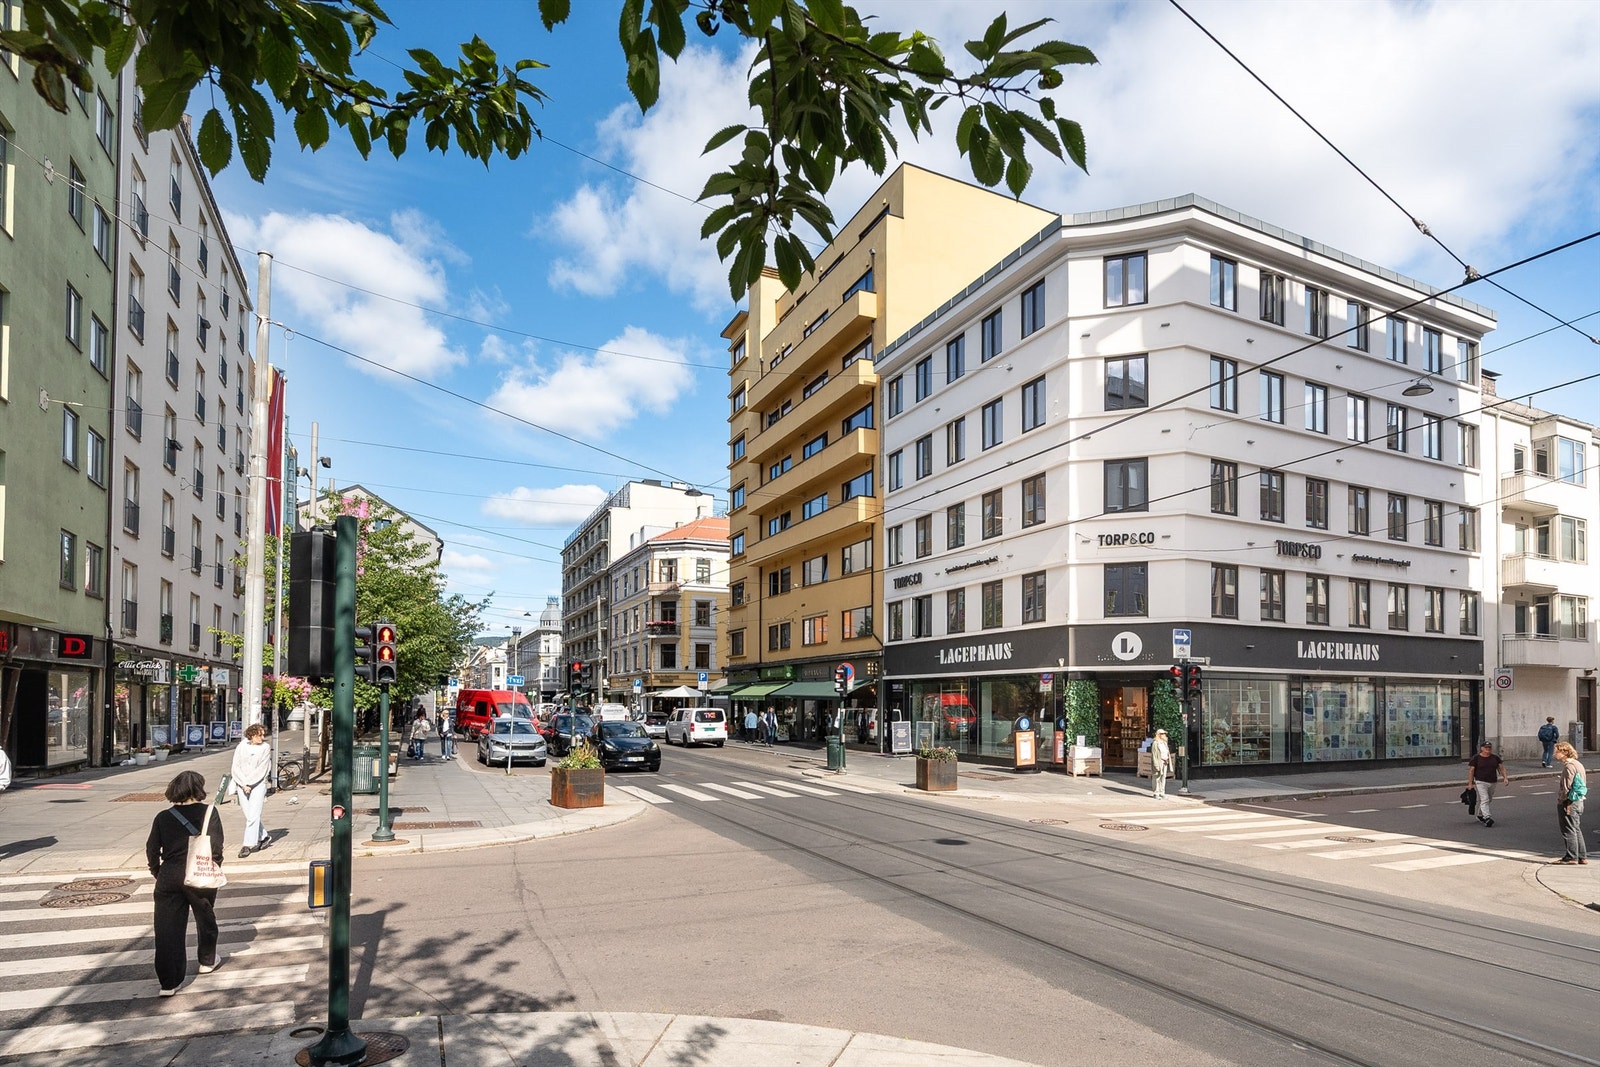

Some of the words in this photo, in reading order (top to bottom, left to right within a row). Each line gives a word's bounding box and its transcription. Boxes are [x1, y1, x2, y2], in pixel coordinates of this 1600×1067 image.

[1097, 531, 1155, 547] TORP&CO
[1276, 539, 1322, 560] TORP&CO
[893, 572, 923, 589] TORP&CO
[938, 642, 1013, 665] LAGERHAUS
[1297, 640, 1380, 661] LAGERHAUS
[1499, 678, 1509, 686] 30
